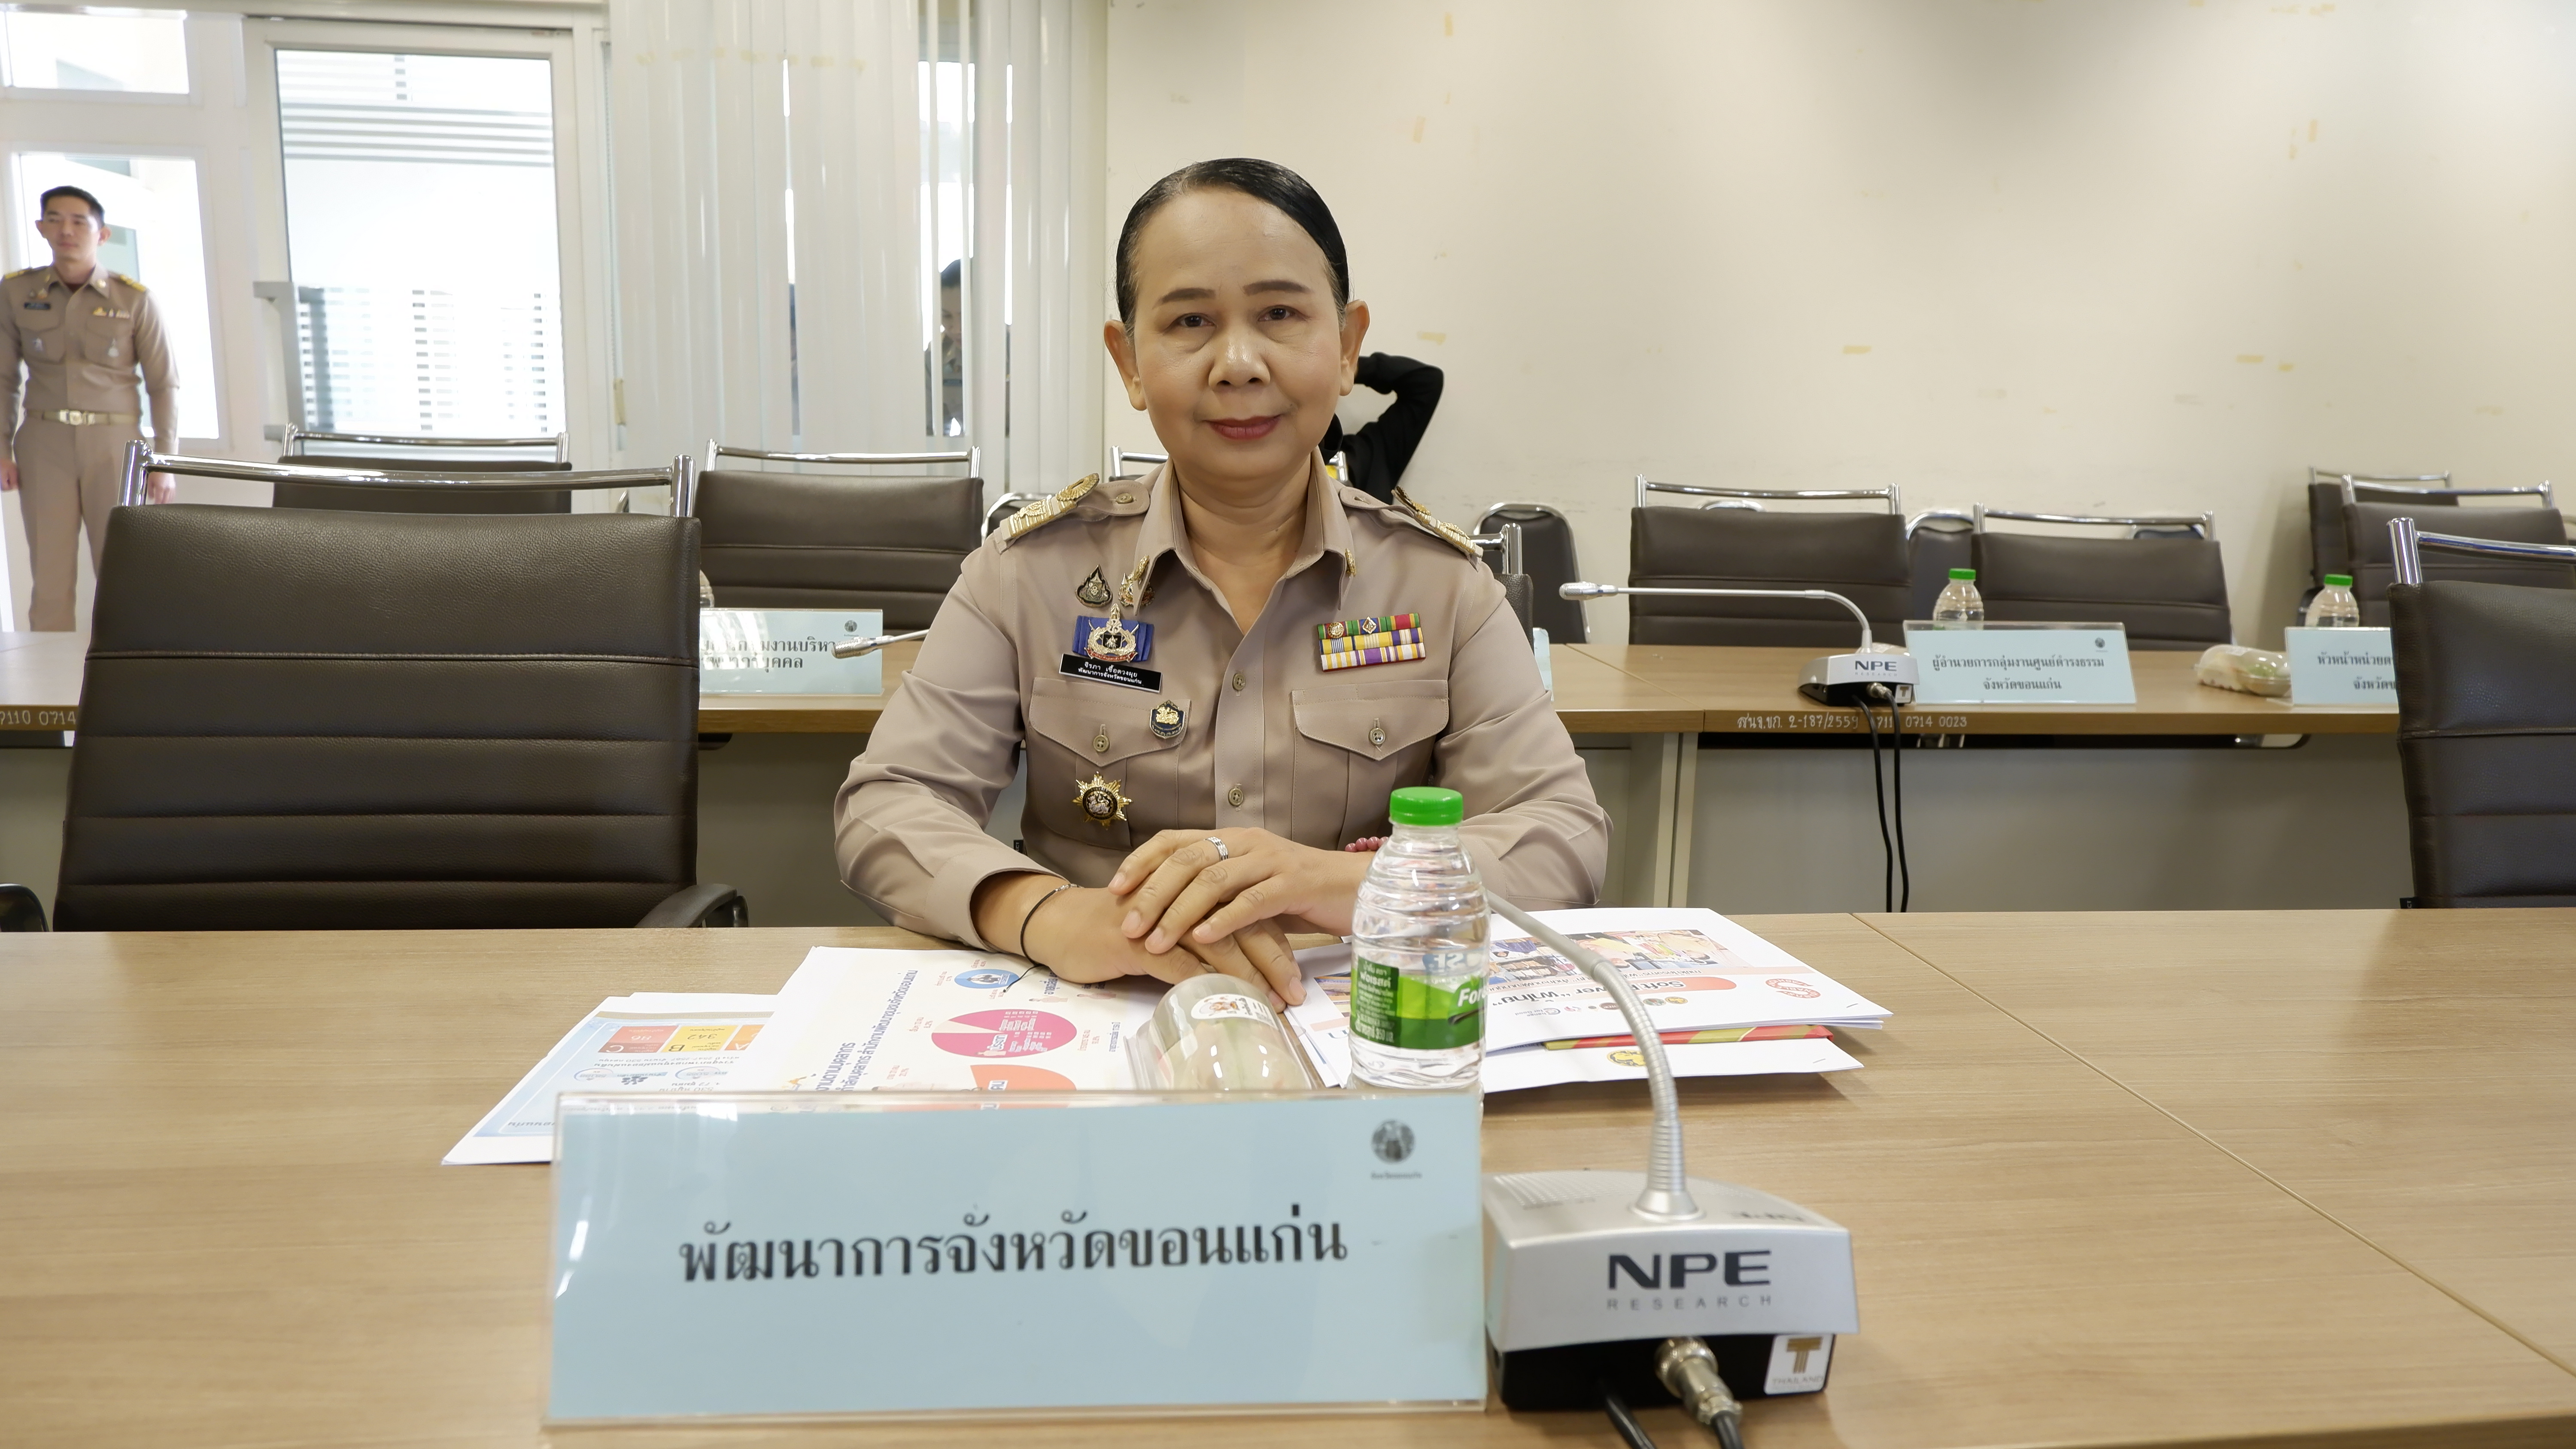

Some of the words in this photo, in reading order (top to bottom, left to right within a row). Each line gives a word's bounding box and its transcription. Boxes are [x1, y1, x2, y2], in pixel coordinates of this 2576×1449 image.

[1855, 660, 1897, 671] NPE
[1078, 667, 1142, 684] พัฒนาการจังหวัดขอนแก่น
[1983, 678, 2062, 690] จังหวัดขอนแก่น
[39, 710, 76, 725] 0714
[1877, 715, 1899, 728] 711
[1905, 715, 1933, 728] 0714
[1939, 715, 1967, 728] 0023
[1643, 980, 1684, 990] Soft
[679, 1204, 1347, 1282] พัฒนาการจังหวัดขอนแก่น
[1608, 1250, 1771, 1289] NPE
[1607, 1294, 1771, 1311] RESEARCH
[1786, 1337, 1823, 1374] T
